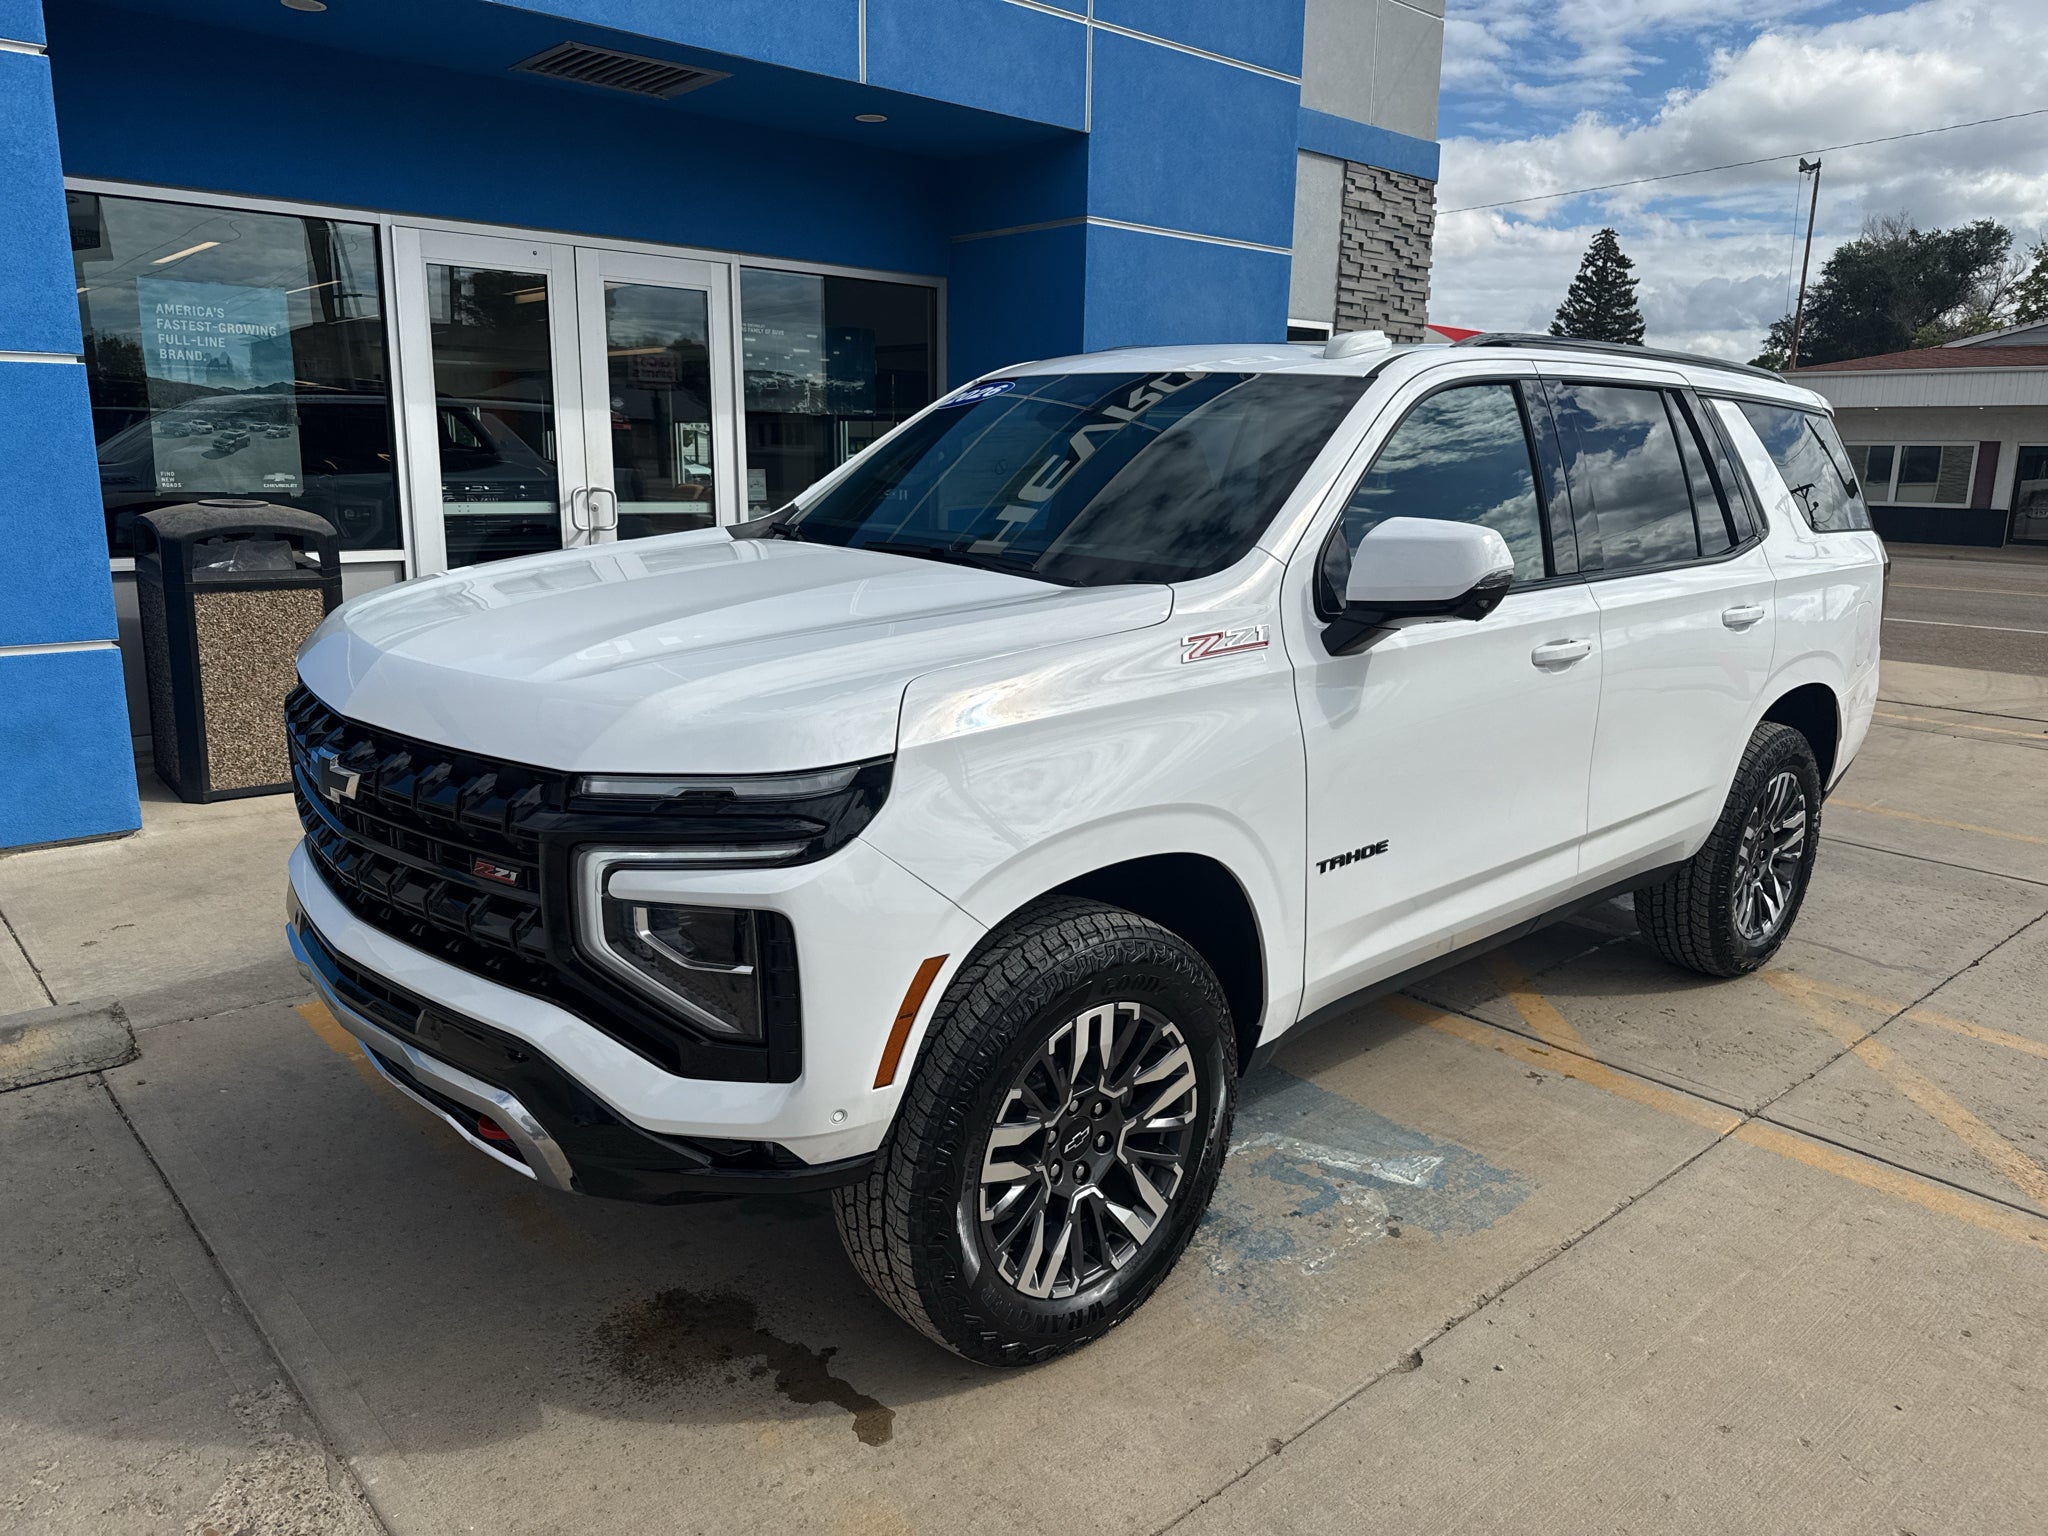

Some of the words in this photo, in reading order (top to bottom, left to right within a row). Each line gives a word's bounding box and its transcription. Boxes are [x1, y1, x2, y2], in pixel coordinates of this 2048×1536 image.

[155, 303, 225, 319] AMERICA'S
[156, 318, 277, 337] FASTEST-GROWING
[158, 333, 226, 348] FULL-LINE
[159, 348, 207, 362] BRAND.
[1181, 624, 1270, 664] Z71
[1316, 839, 1389, 875] TAHOE
[473, 861, 518, 885] Z71
